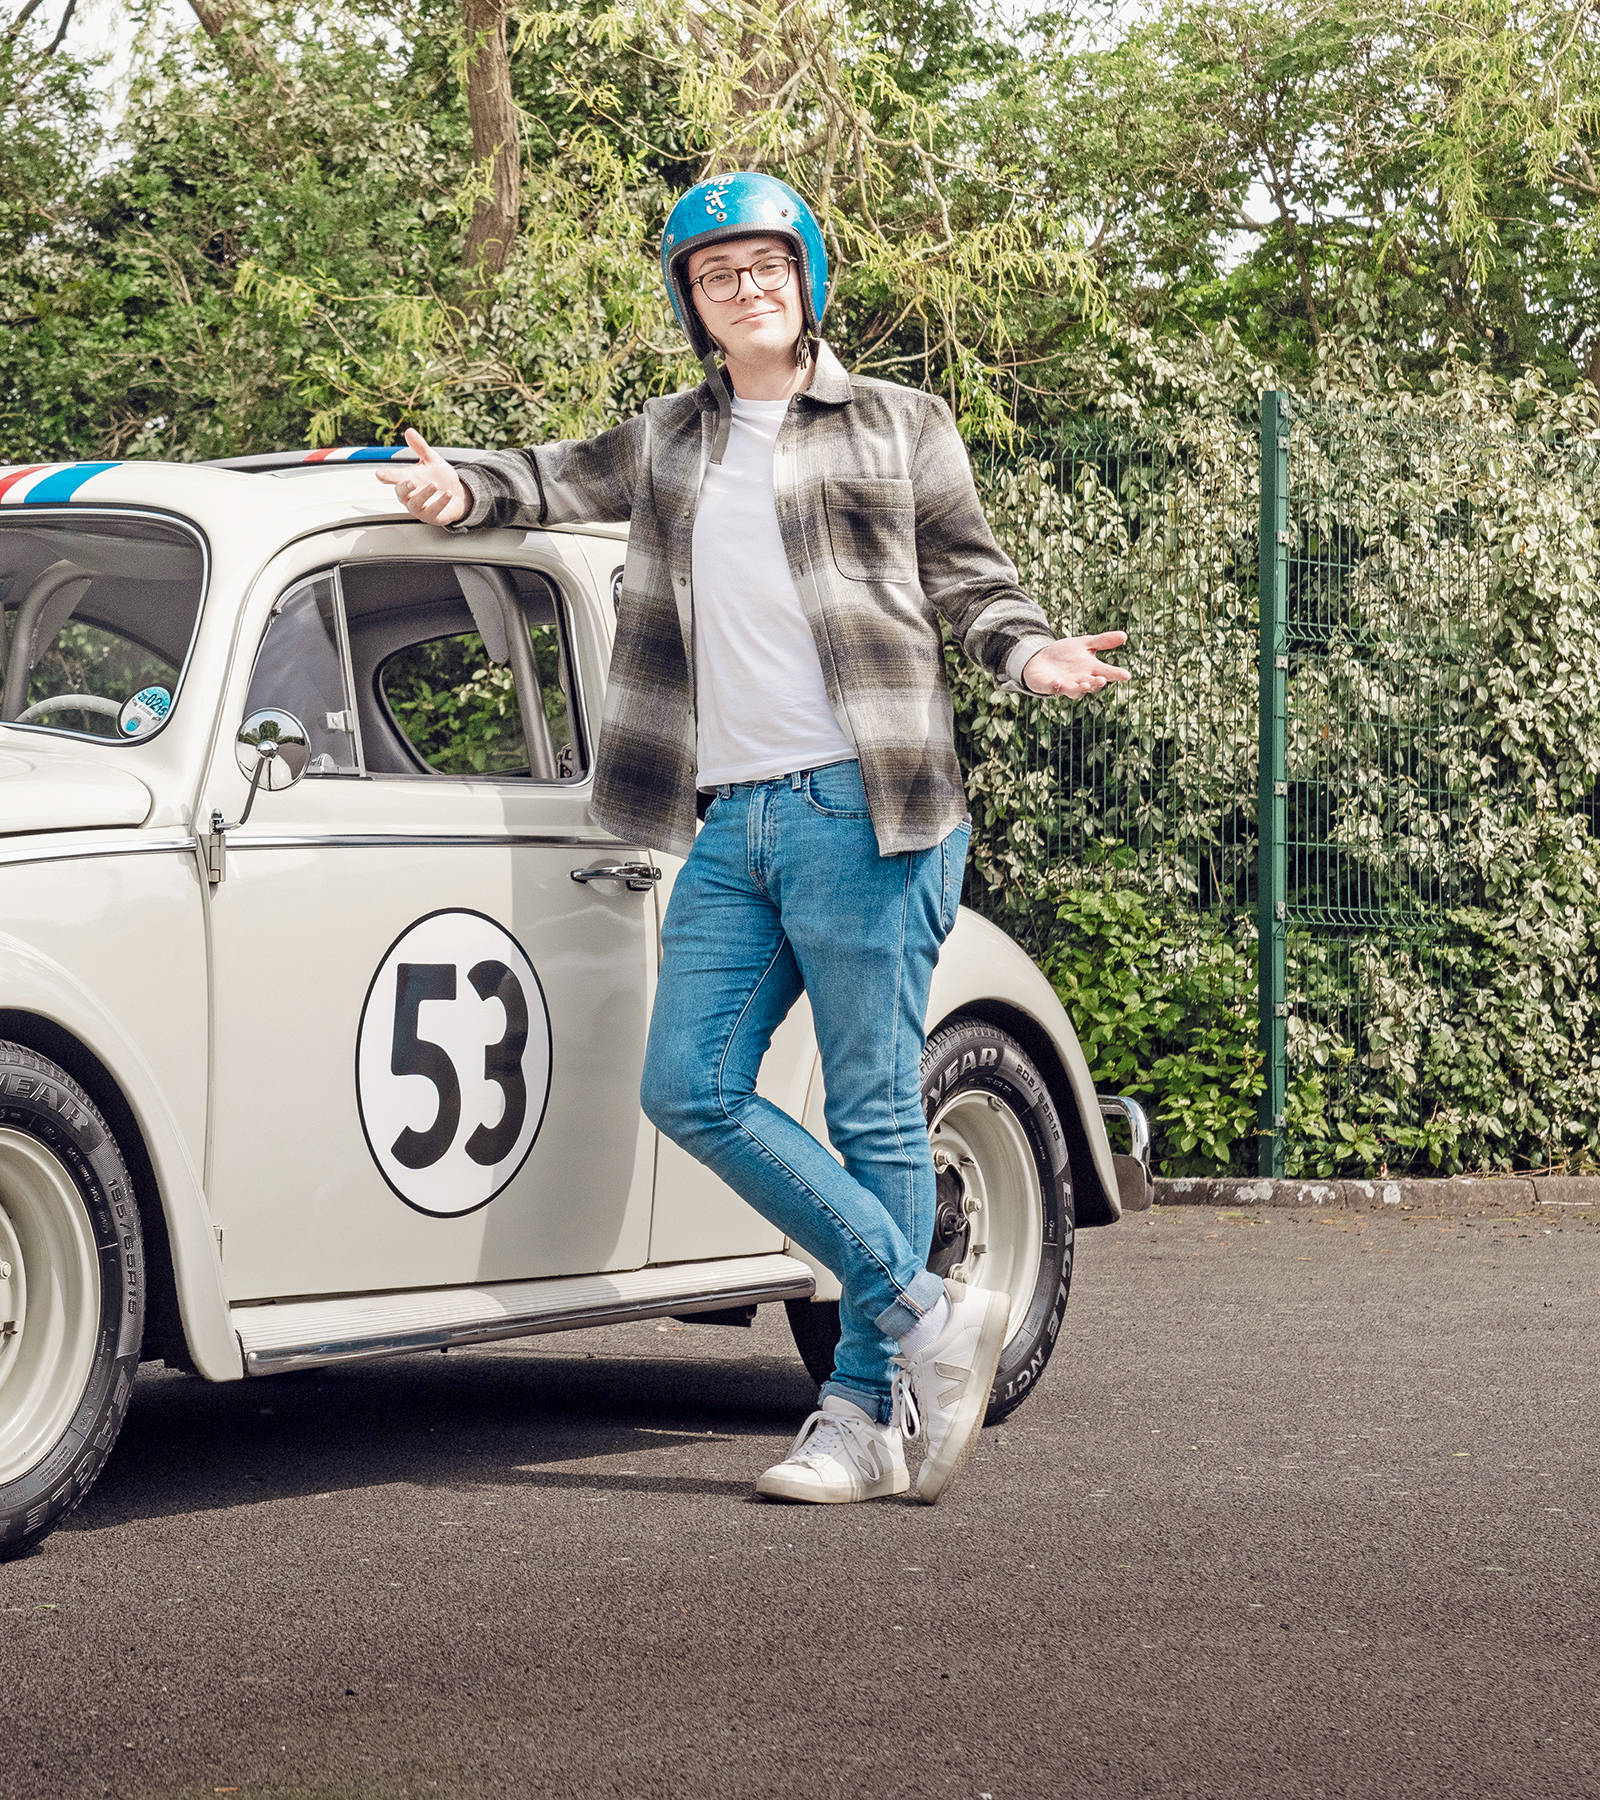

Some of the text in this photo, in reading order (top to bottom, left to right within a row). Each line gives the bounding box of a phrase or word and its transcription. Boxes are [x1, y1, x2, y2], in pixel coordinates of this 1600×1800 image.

[145, 694, 163, 710] 02
[155, 704, 167, 716] 15
[390, 959, 529, 1170] 53
[1046, 1180, 1075, 1344] EAGLE
[23, 1365, 131, 1536] EAGLE
[1004, 1347, 1046, 1400] NCT
